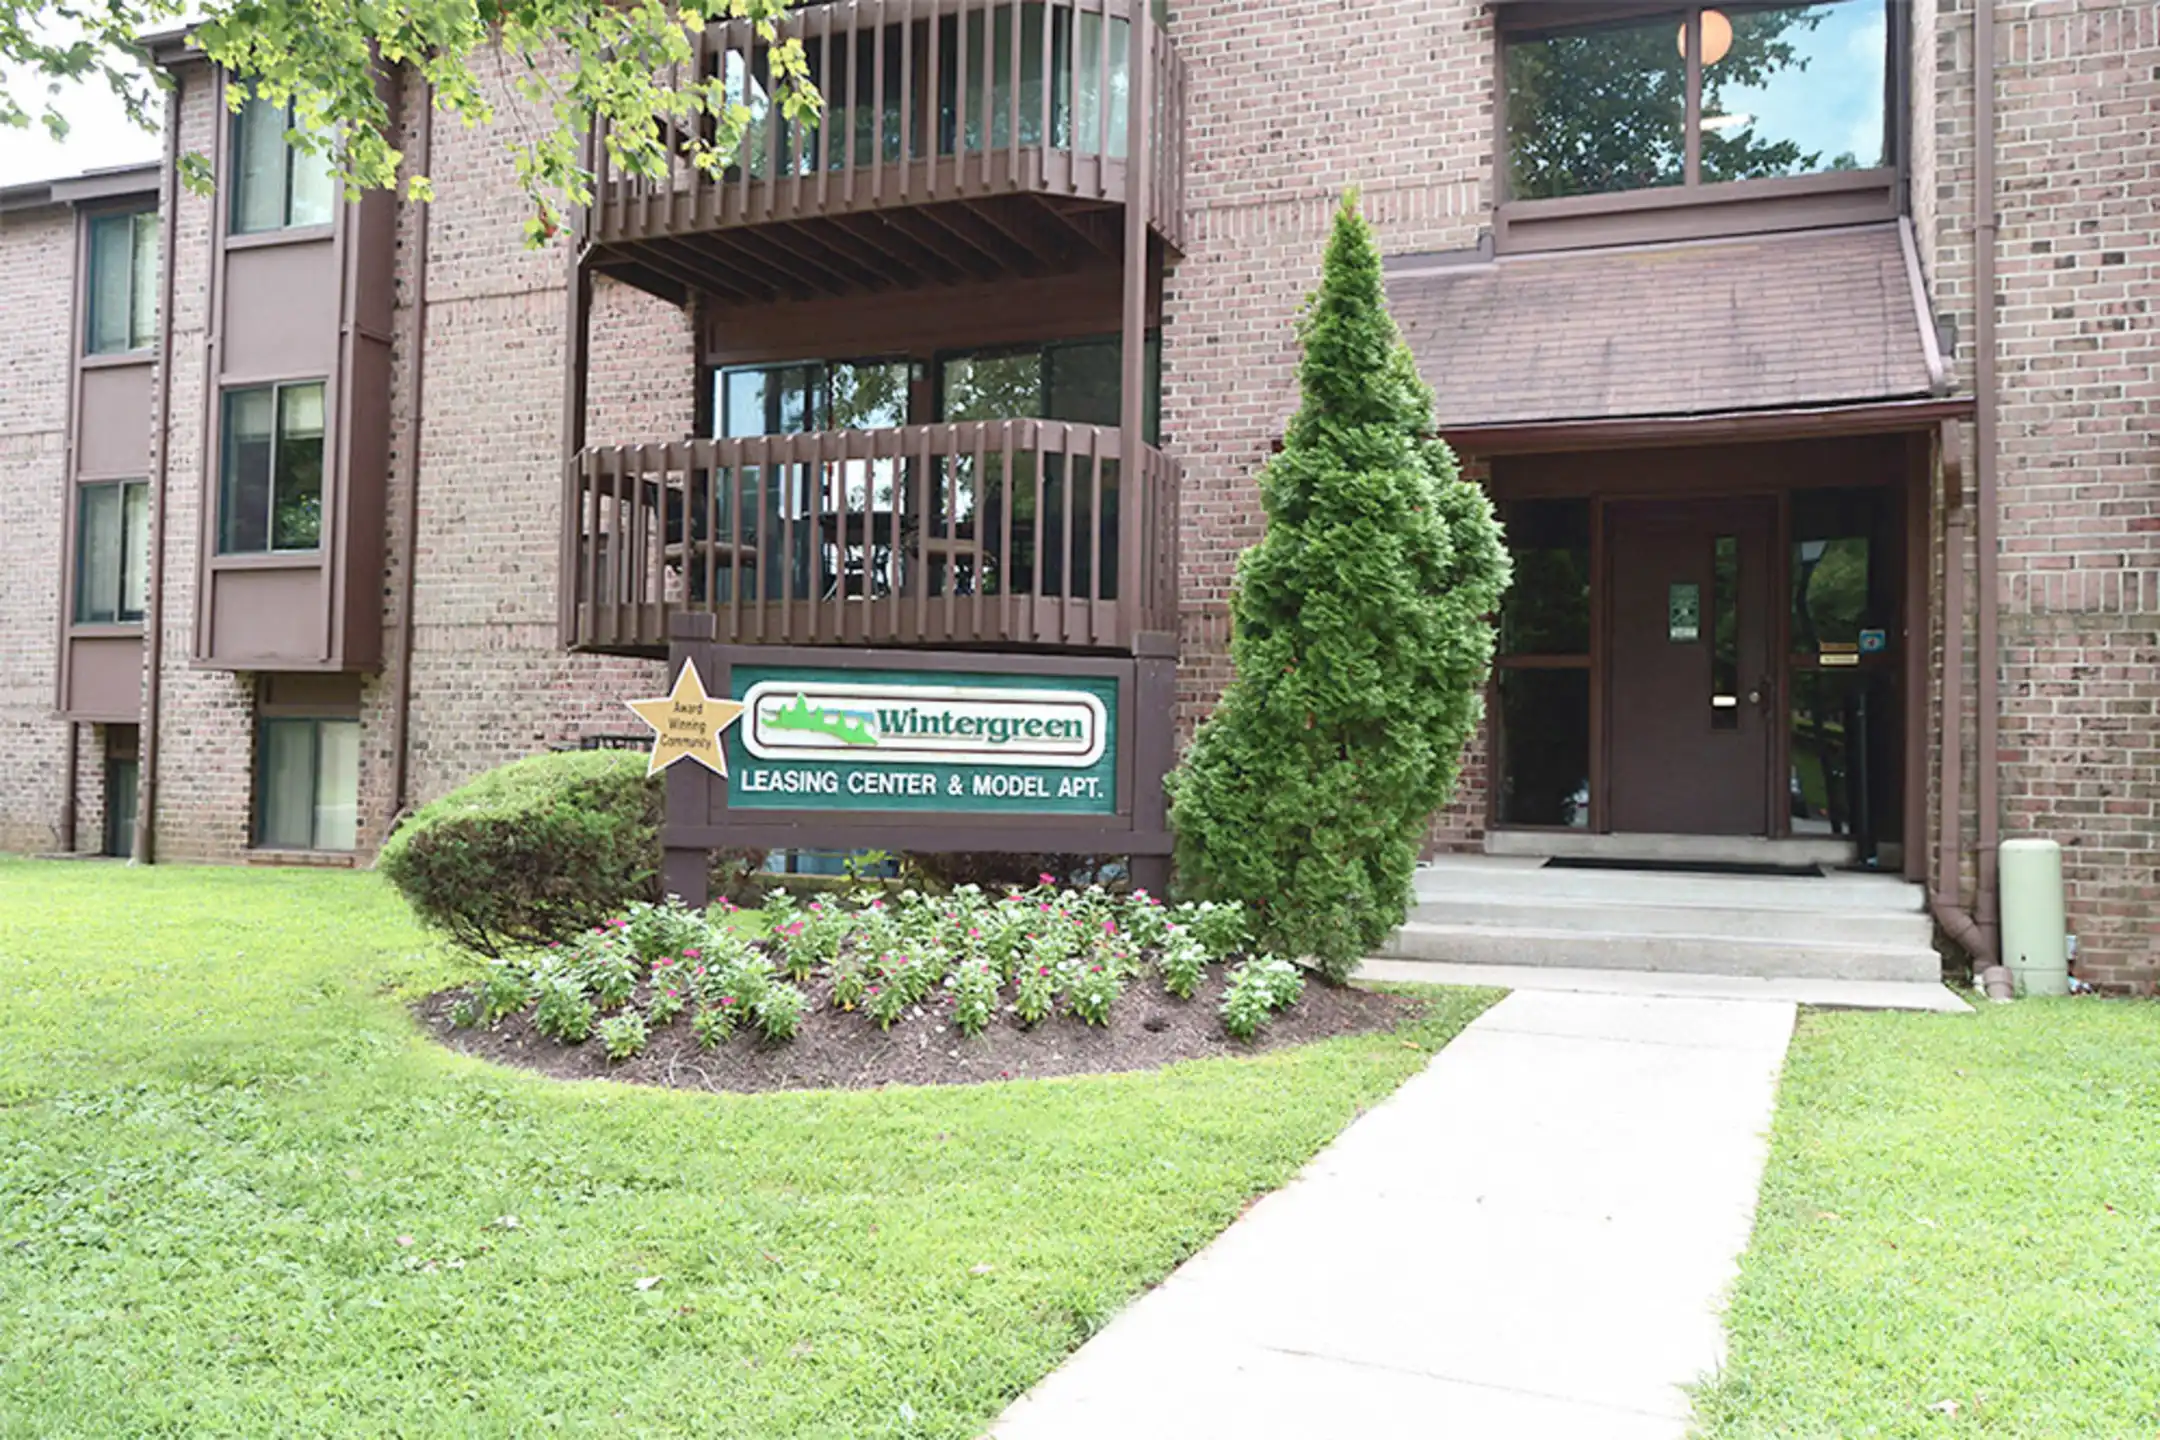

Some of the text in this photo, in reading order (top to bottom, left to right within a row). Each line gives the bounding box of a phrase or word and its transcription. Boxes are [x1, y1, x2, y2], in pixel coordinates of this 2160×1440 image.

[673, 701, 704, 715] Award
[667, 717, 707, 735] Winning
[877, 707, 1084, 743] Wintergreen
[660, 733, 712, 751] Community
[740, 769, 1104, 798] LEASING CENTER & MODEL APT.
